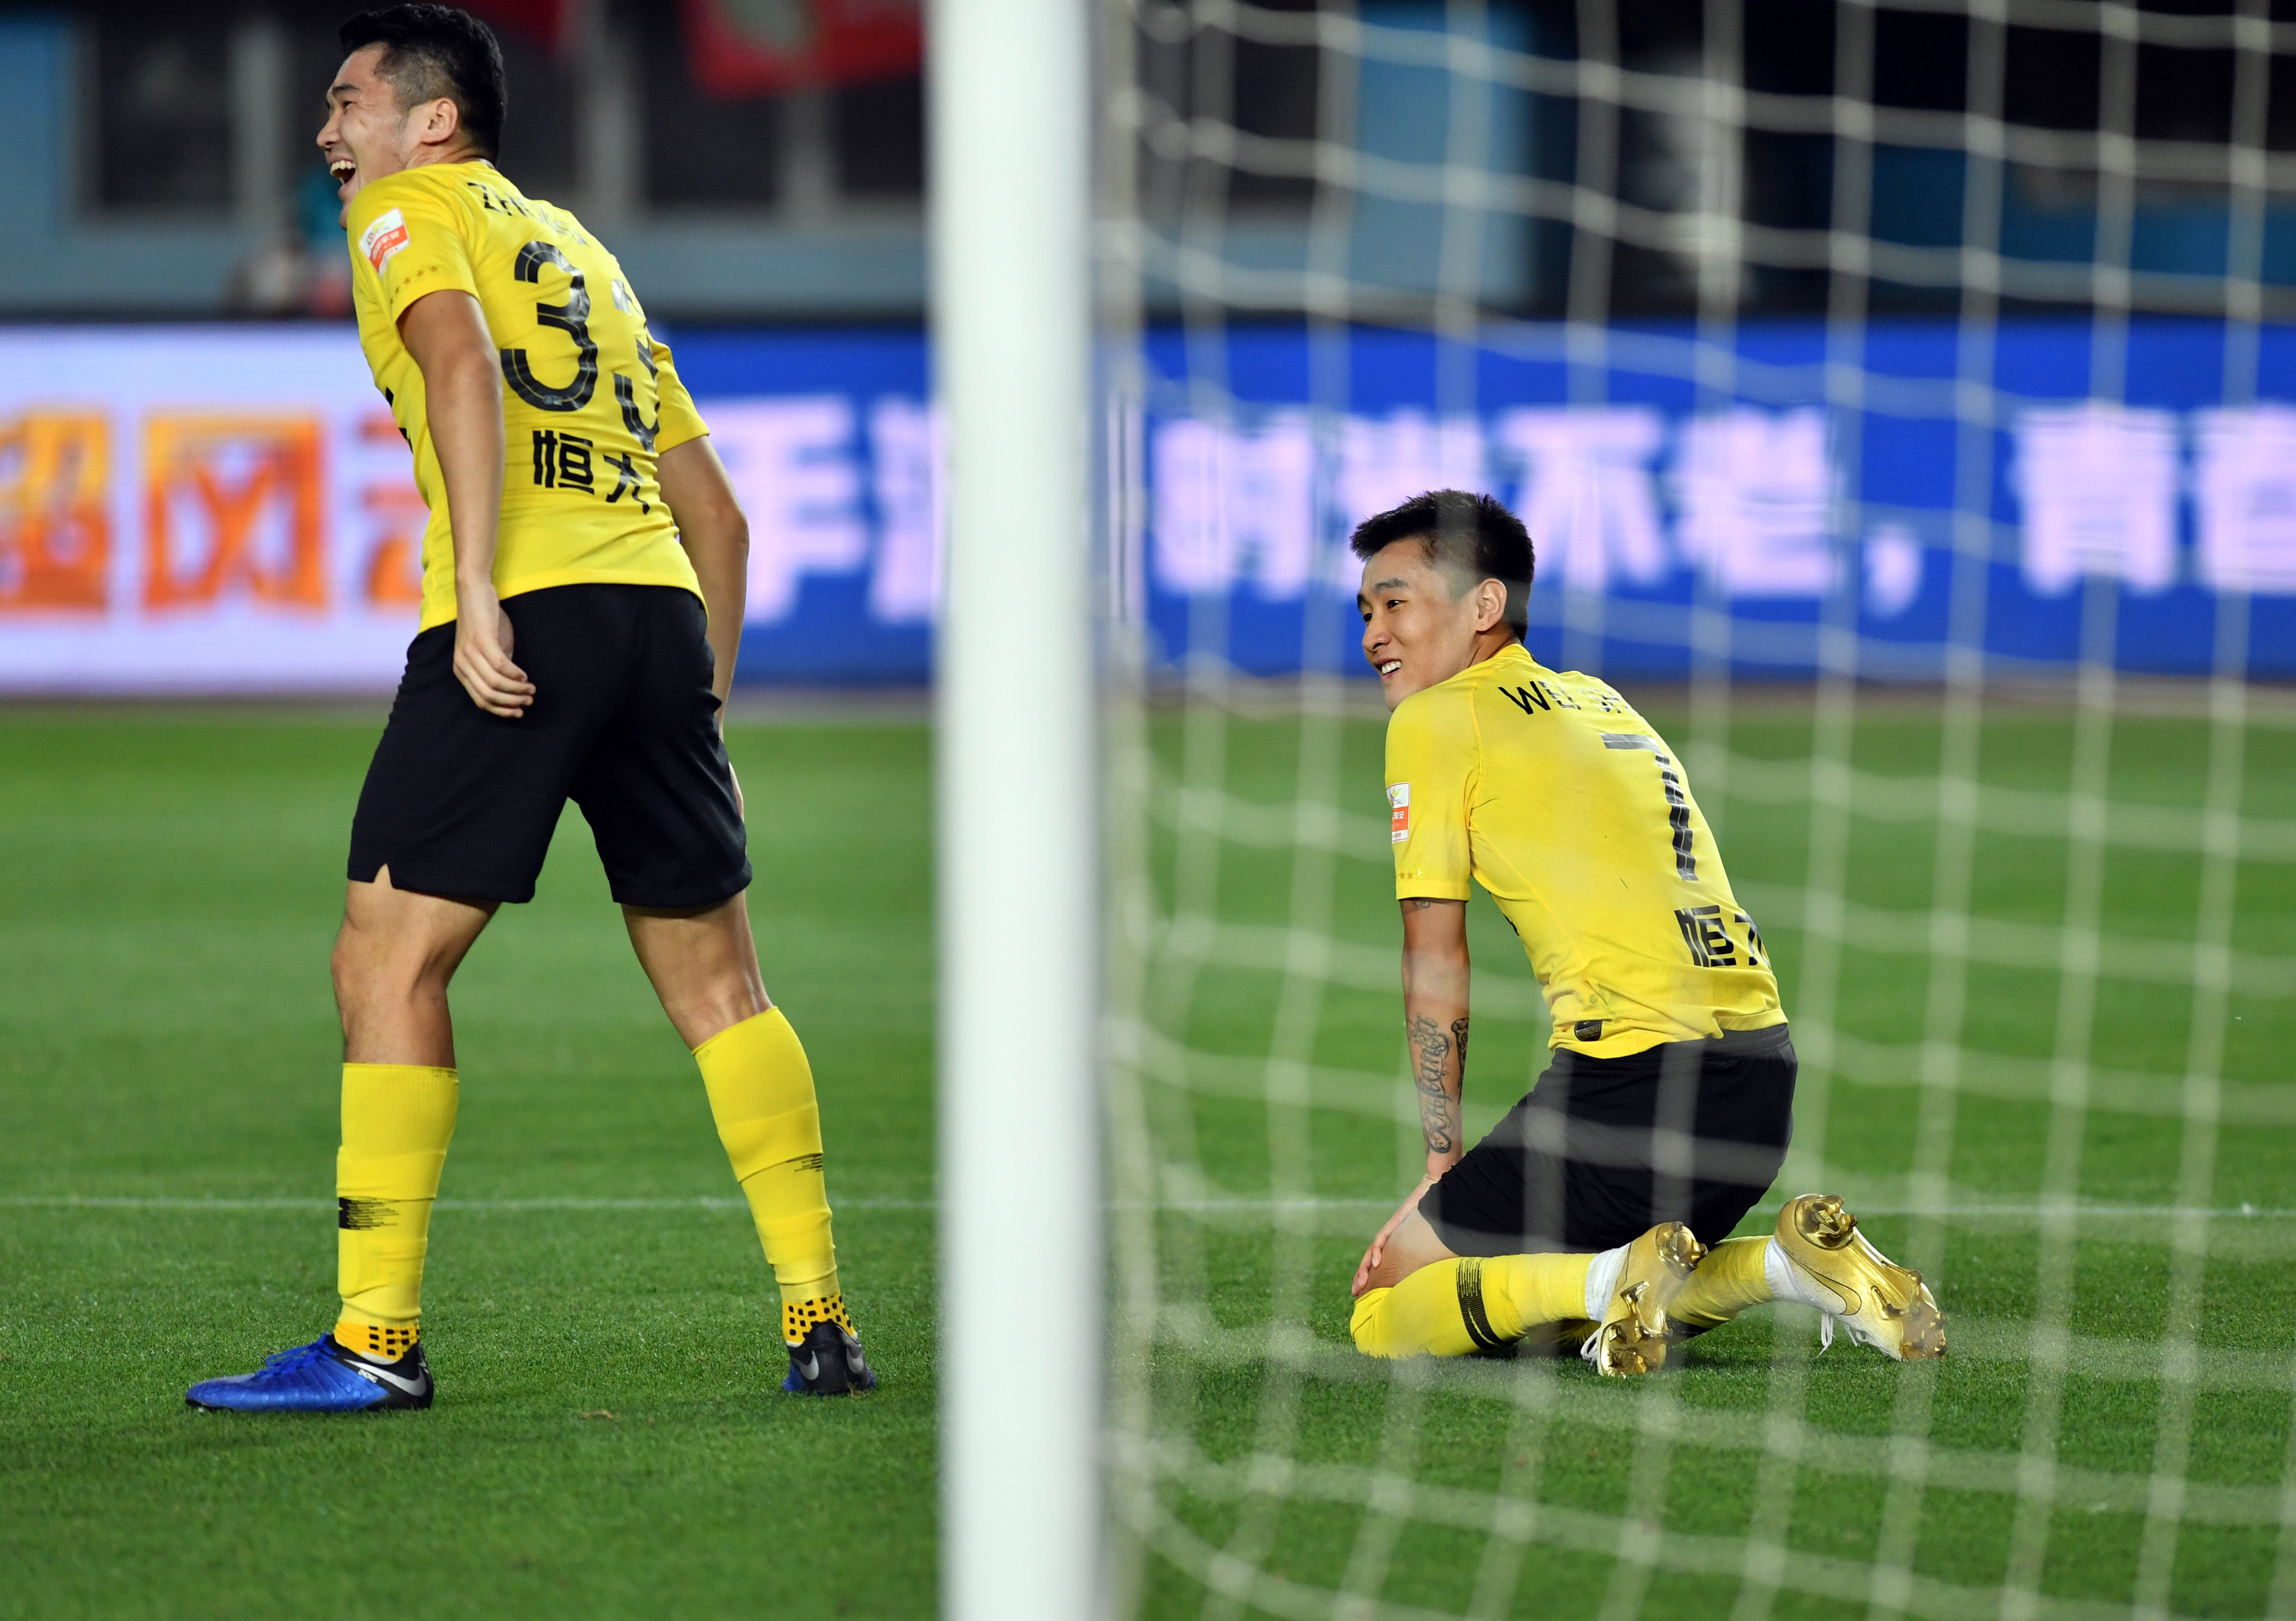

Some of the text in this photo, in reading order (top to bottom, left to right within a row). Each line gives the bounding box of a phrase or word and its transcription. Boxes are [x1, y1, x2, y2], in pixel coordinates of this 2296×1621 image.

[532, 430, 650, 515] 恒大
[1497, 681, 1582, 715] WEI
[1599, 733, 1699, 881] 7
[1674, 904, 1772, 970] 恒大
[1817, 1209, 1835, 1224] NIKE
